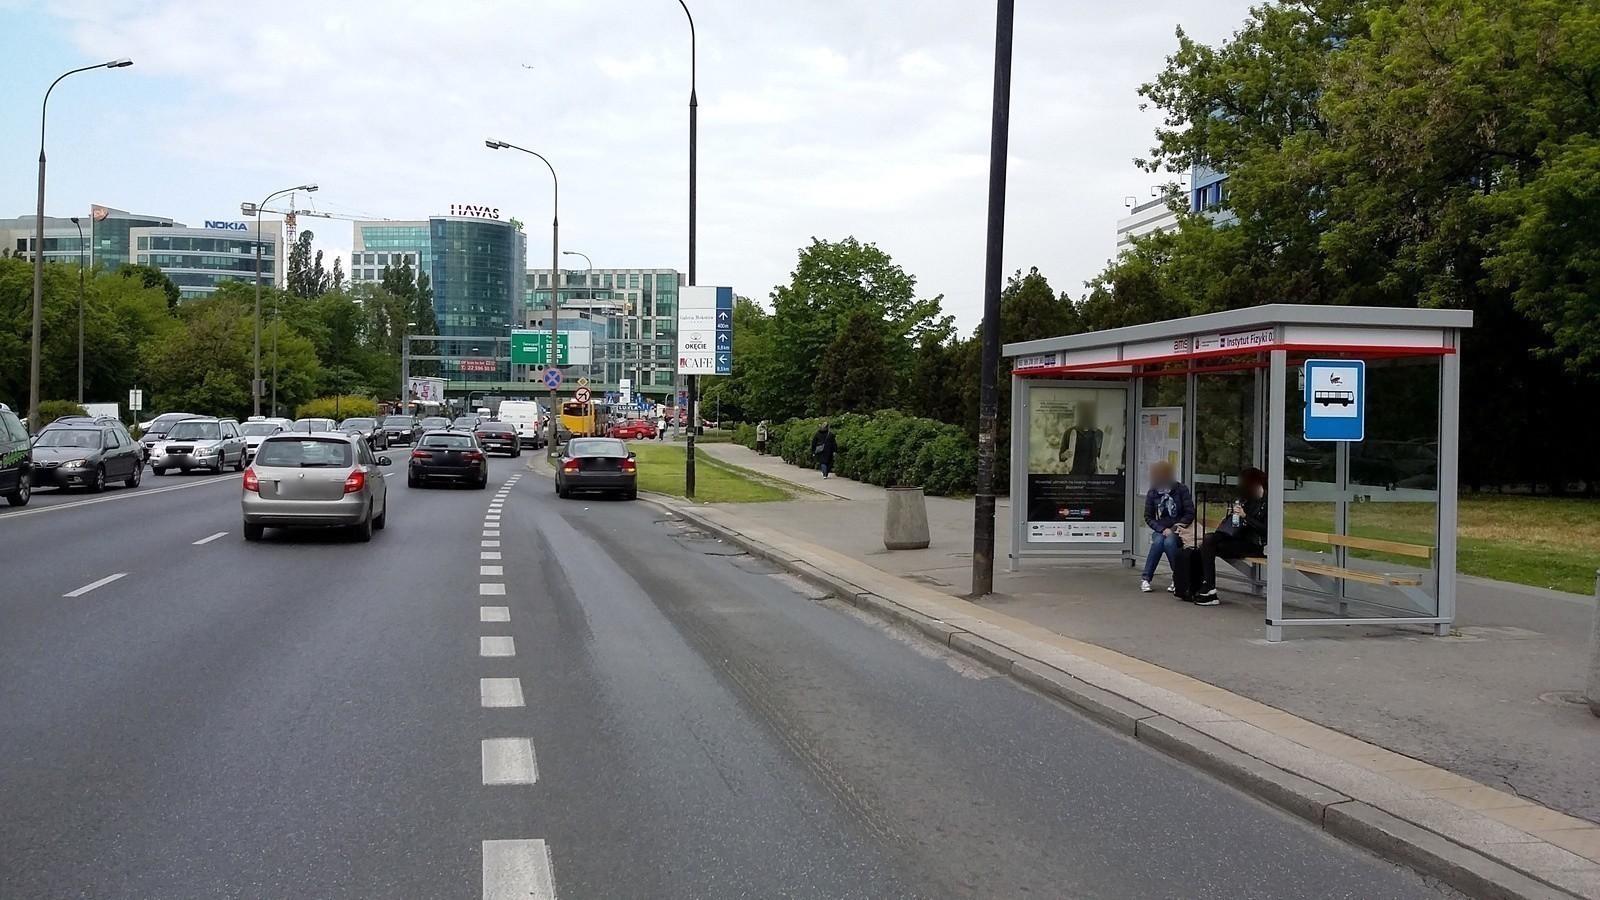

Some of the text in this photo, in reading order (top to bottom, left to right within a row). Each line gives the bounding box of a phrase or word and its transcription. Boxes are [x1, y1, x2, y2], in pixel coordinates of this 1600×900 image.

[451, 204, 499, 219] HAVAS
[205, 221, 247, 231] NOKIA
[1227, 336, 1249, 349] Instytut
[1251, 332, 1267, 345] Fizyki
[685, 343, 707, 351] OKĘCIE
